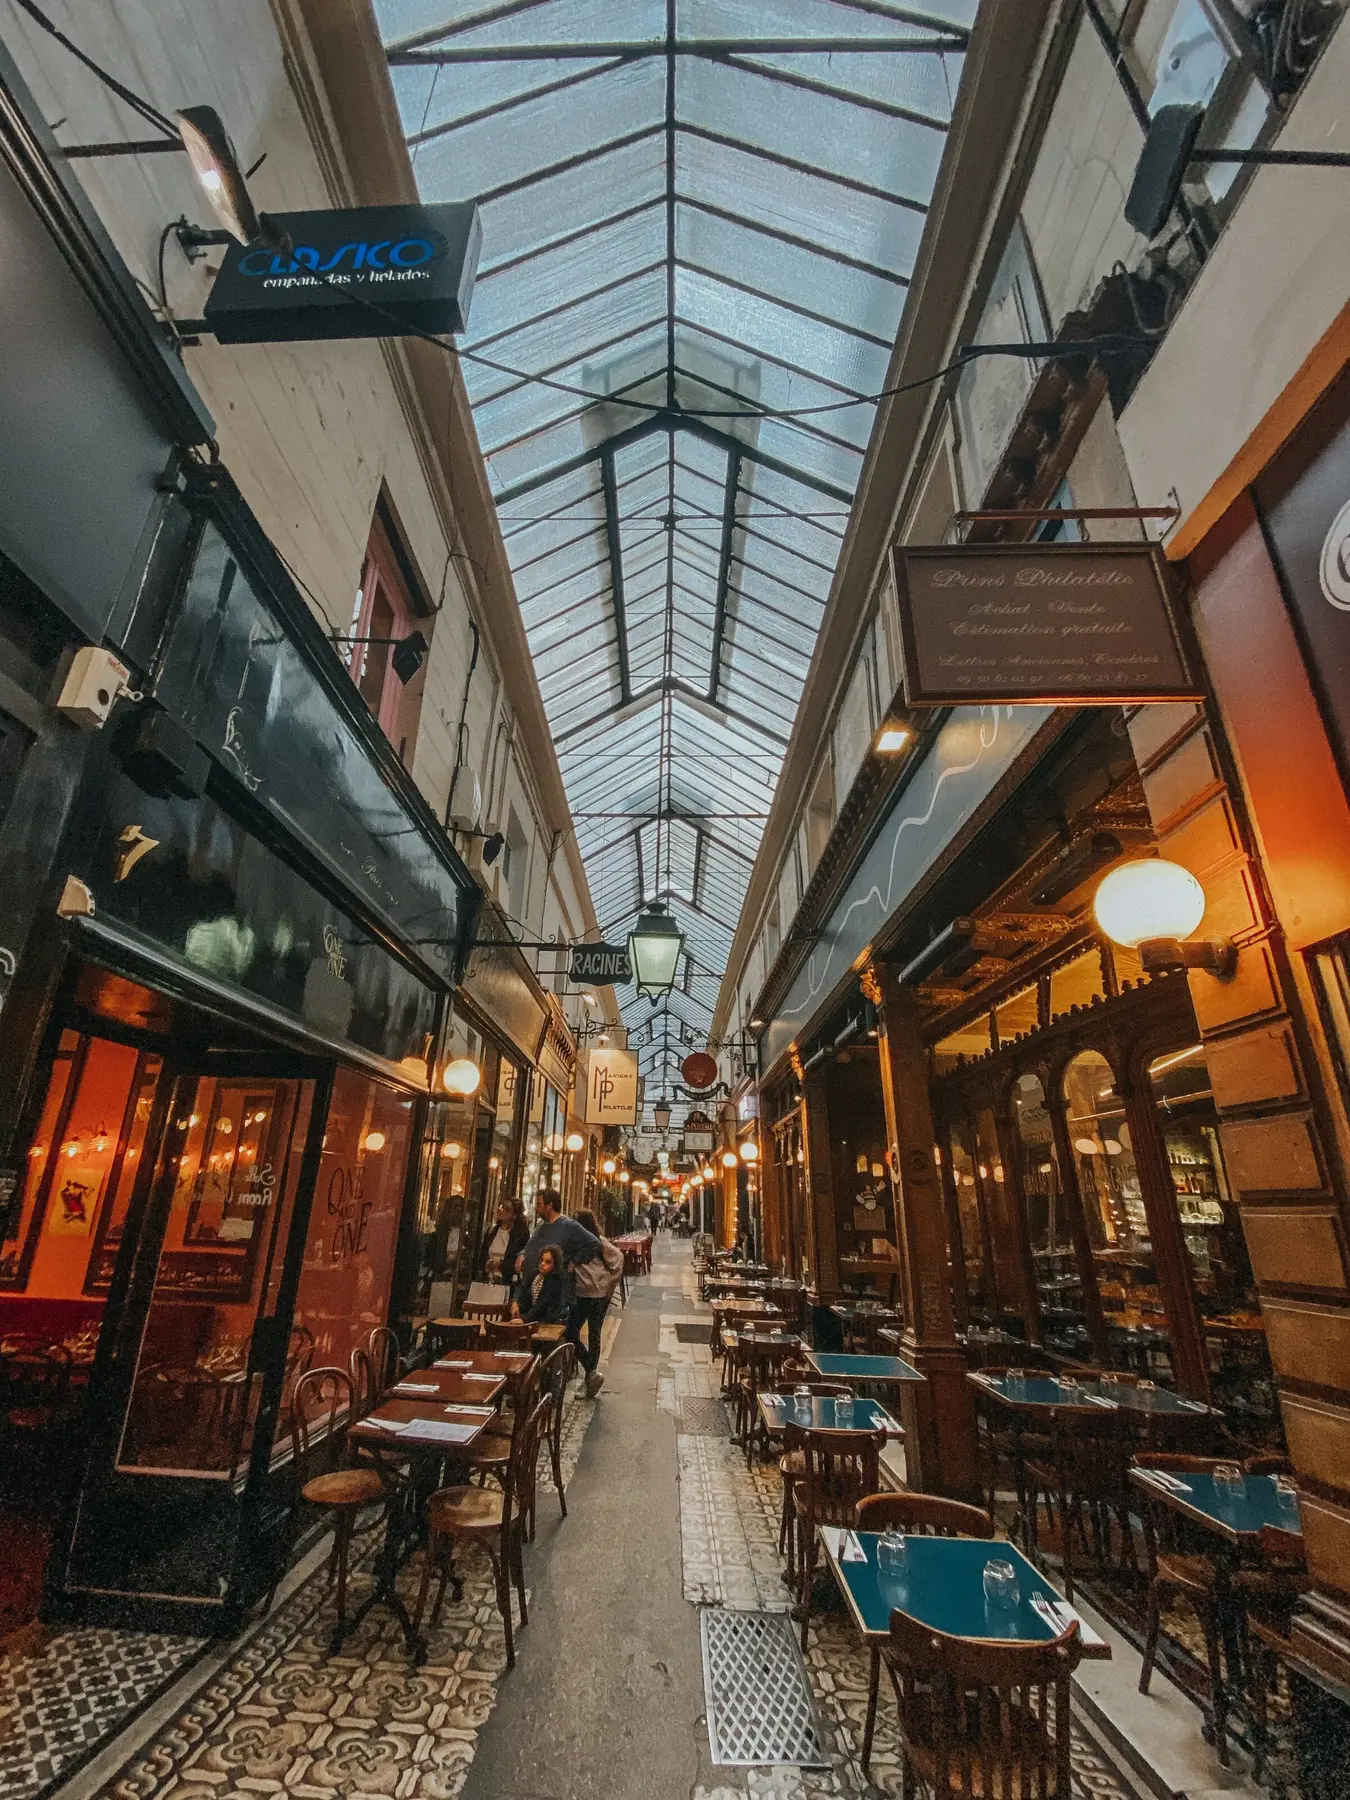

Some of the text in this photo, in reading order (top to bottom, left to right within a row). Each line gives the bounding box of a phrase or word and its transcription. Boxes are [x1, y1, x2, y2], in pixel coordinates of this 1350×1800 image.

[237, 238, 434, 276] CLASICO
[263, 273, 351, 289] empandas
[369, 268, 430, 283] helados
[968, 601, 1032, 616] Achat
[948, 620, 1133, 638] Estimation gratuite
[117, 825, 160, 882] 7
[571, 951, 632, 976] RACINES
